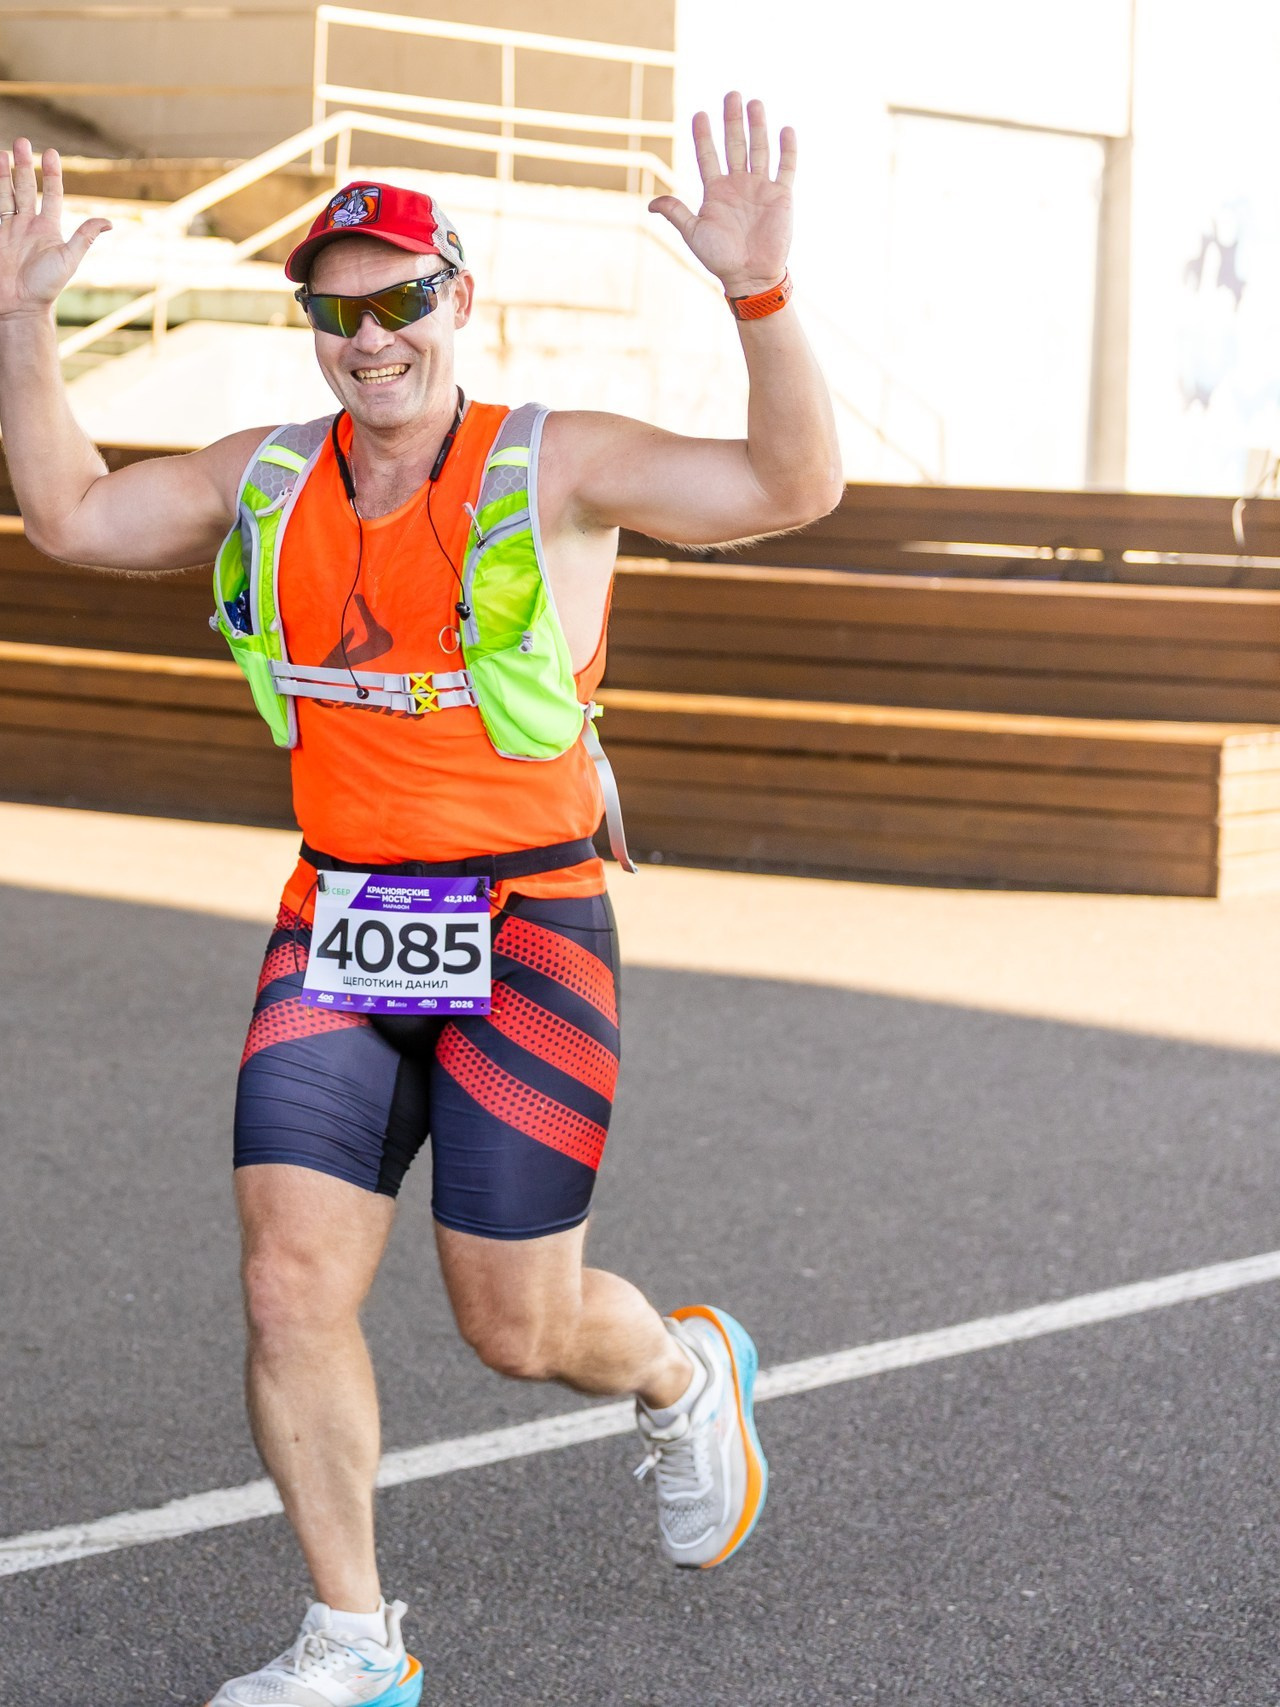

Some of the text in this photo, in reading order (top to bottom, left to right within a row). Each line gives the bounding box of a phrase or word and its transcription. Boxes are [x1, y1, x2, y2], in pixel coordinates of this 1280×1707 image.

[332, 888, 350, 896] СБЕР
[367, 886, 430, 897] КРАСНОЯРСКИЕ
[382, 895, 411, 904] МОСТЫ
[444, 895, 462, 903] 42,2
[316, 918, 482, 975] 4085
[343, 976, 448, 990] ЩЕПОТКИН ДАНИЛ
[450, 1000, 474, 1008] 2026
